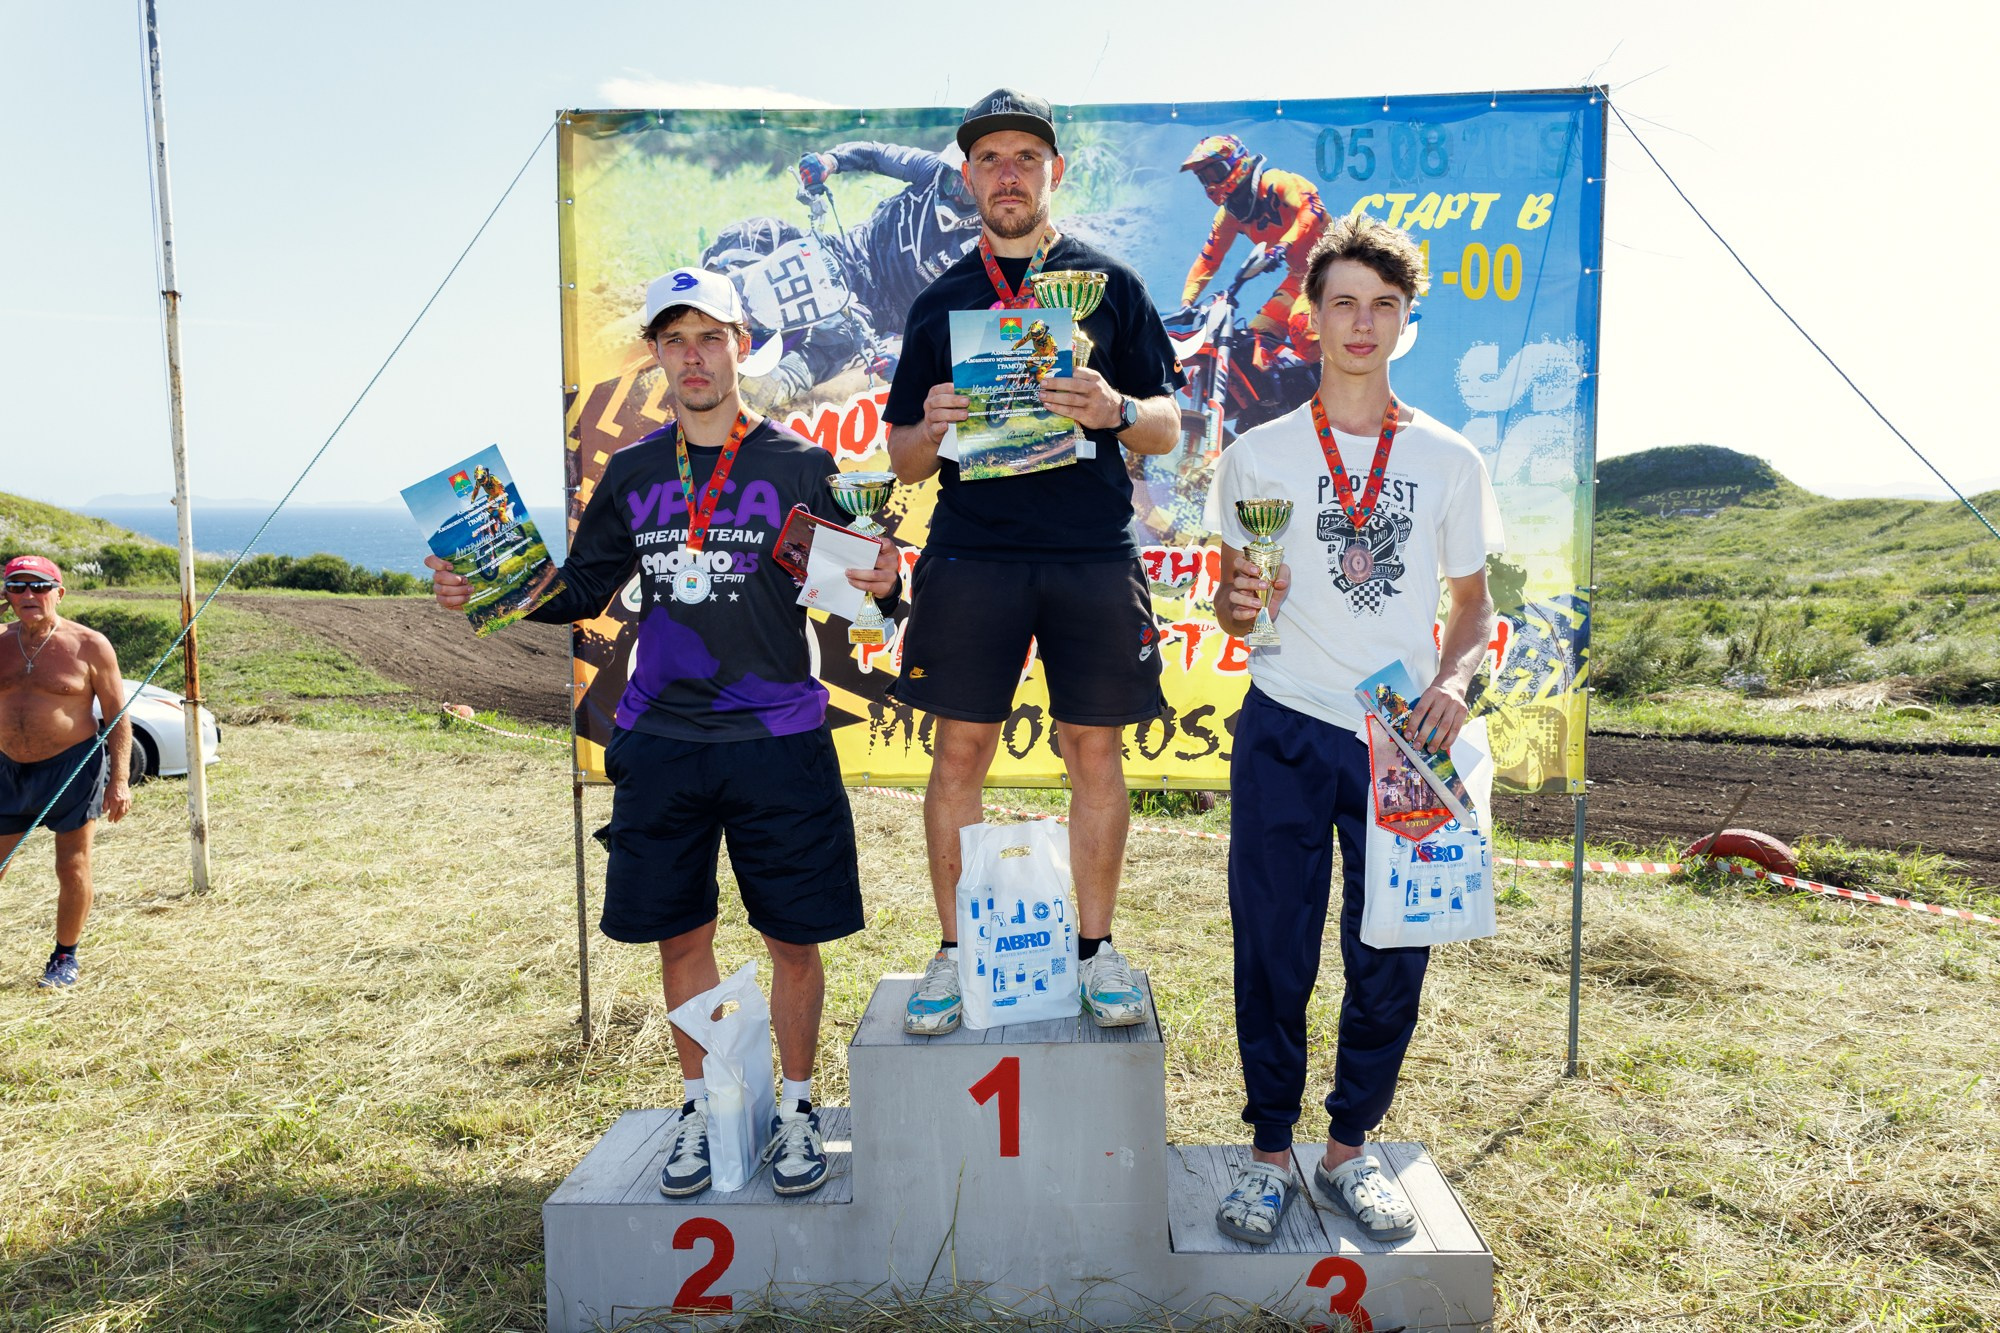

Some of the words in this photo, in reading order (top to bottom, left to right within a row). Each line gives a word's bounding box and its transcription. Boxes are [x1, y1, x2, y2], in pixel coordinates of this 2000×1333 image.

[1315, 127, 1376, 183] 05
[1348, 192, 1501, 231] СТАРТ
[1516, 192, 1555, 231] В
[764, 255, 821, 328] 595
[997, 362, 1027, 370] ГРАМОТА
[635, 529, 690, 547] DREAM
[707, 528, 765, 544] TEAM
[1373, 529, 1388, 544] AND
[1410, 819, 1429, 827] ЭТАП
[995, 930, 1051, 953] ABRO
[968, 1056, 1020, 1158] 1
[672, 1217, 735, 1316] 2
[1306, 1256, 1373, 1333] 3
